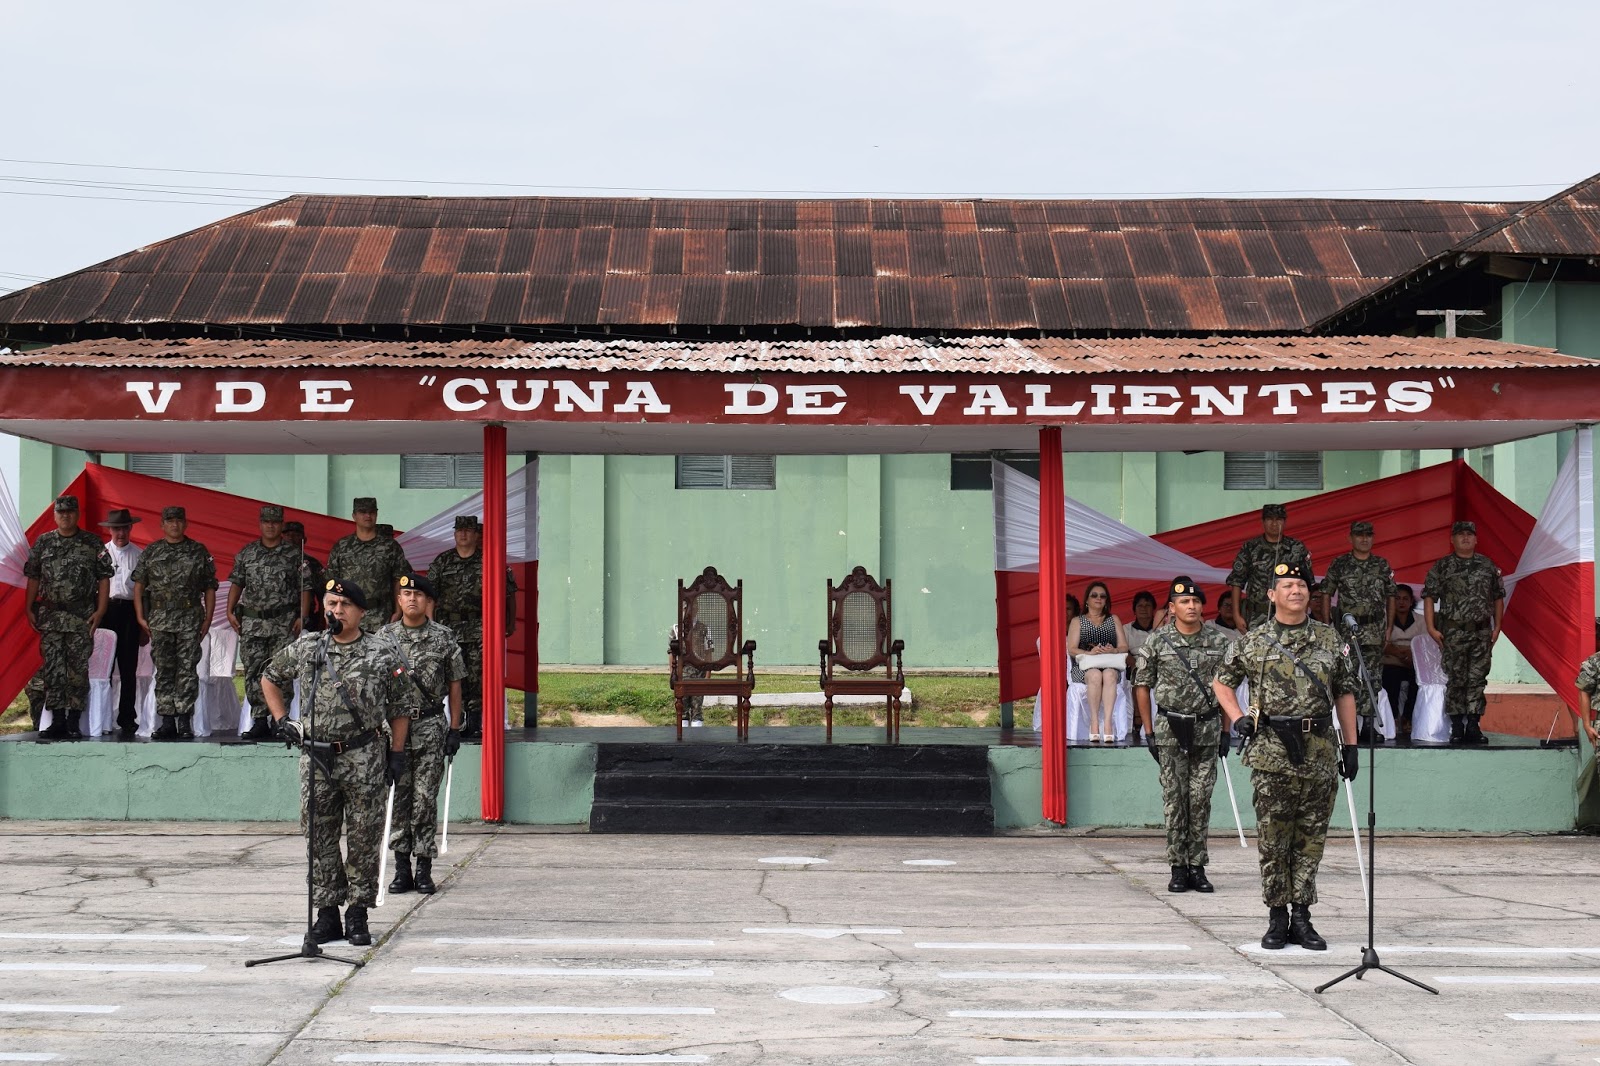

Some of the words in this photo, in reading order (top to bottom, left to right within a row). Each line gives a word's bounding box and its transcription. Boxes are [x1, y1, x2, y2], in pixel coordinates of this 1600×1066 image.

[125, 381, 182, 414] V
[214, 381, 267, 413] D
[299, 380, 355, 413] E
[418, 375, 671, 414] "CUNA
[723, 383, 848, 416] DE
[898, 376, 1456, 417] VALIENTES"
